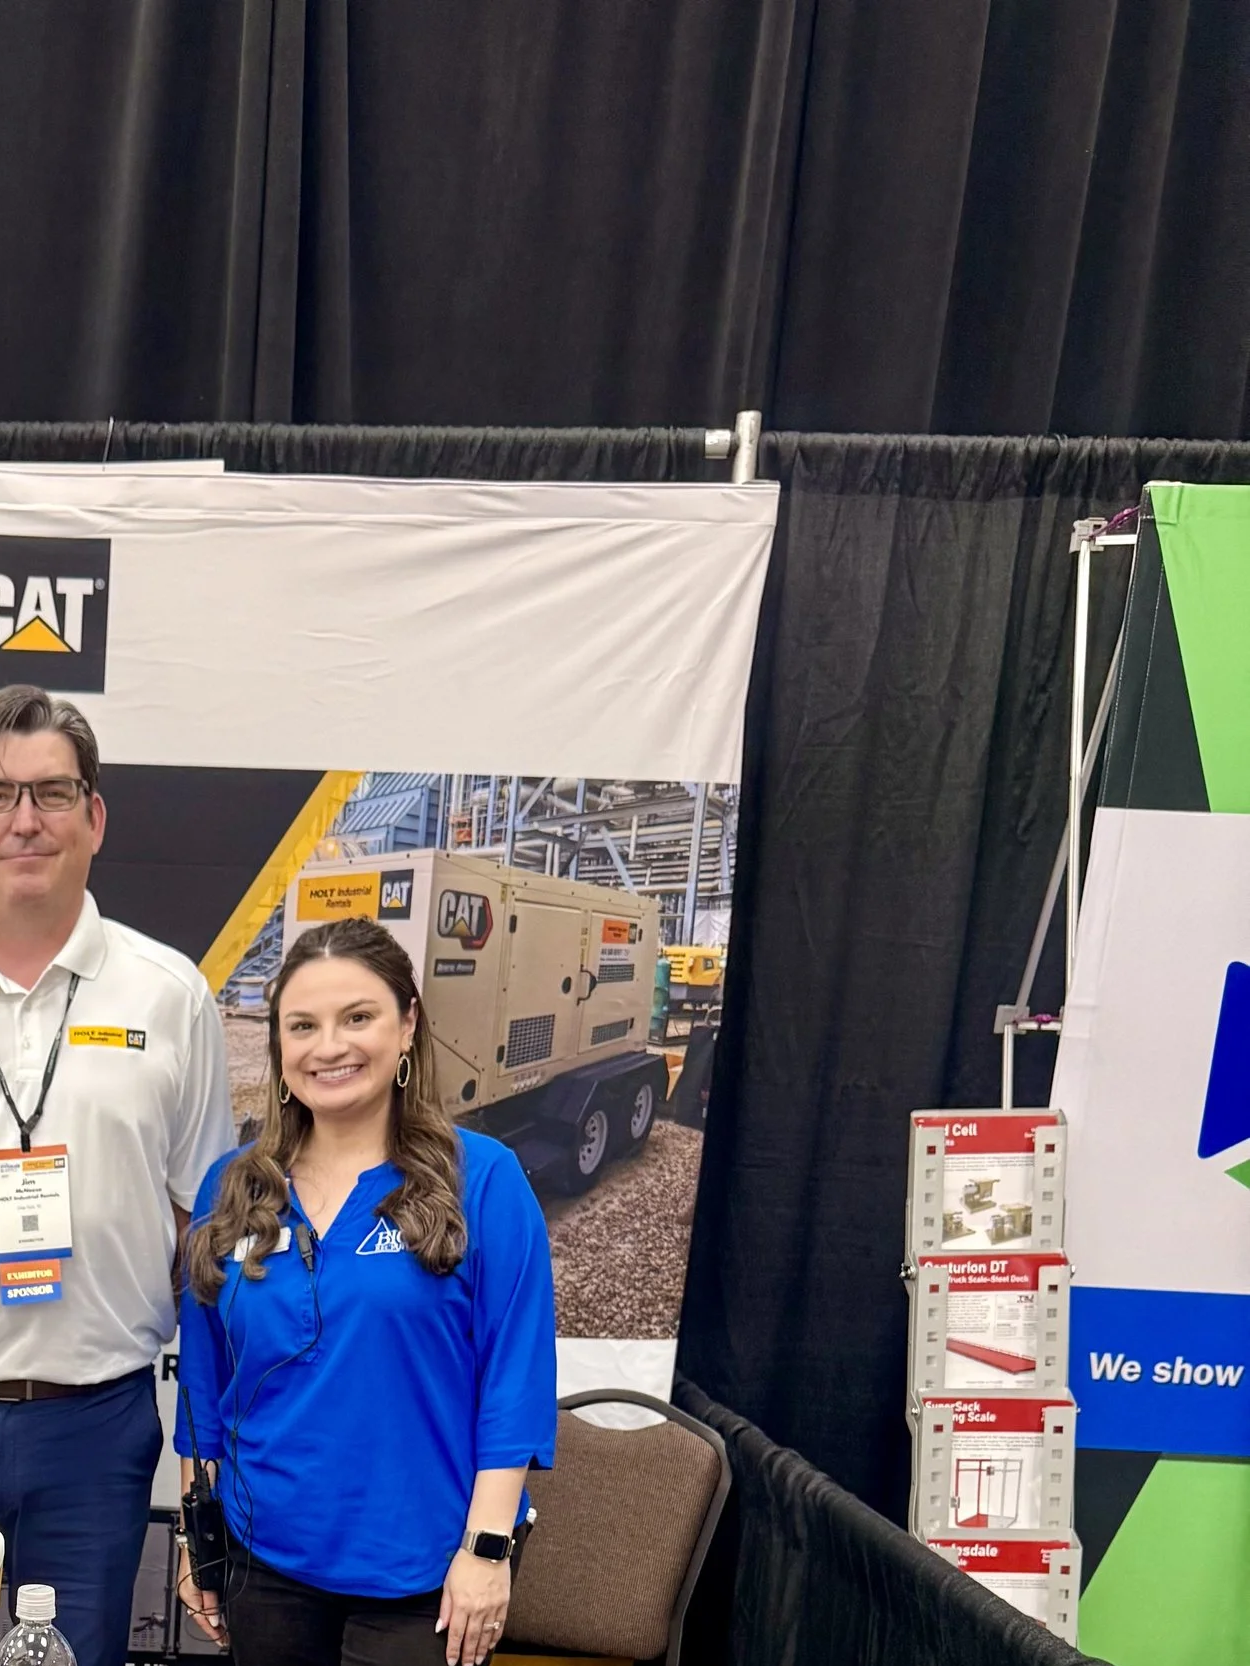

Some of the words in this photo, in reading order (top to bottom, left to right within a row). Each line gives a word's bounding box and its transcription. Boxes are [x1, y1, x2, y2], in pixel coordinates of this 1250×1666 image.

[310, 888, 335, 898] HOLT
[337, 885, 372, 897] Industrial
[381, 882, 410, 908] CAT
[325, 899, 352, 908] Rentals
[440, 891, 483, 937] CAT
[989, 1260, 1008, 1274] DT
[6, 1268, 53, 1281] EXHIBITOR
[7, 1284, 54, 1299] SPONSOR
[1090, 1352, 1142, 1382] We
[1152, 1356, 1245, 1387] show
[967, 1412, 996, 1423] Scale
